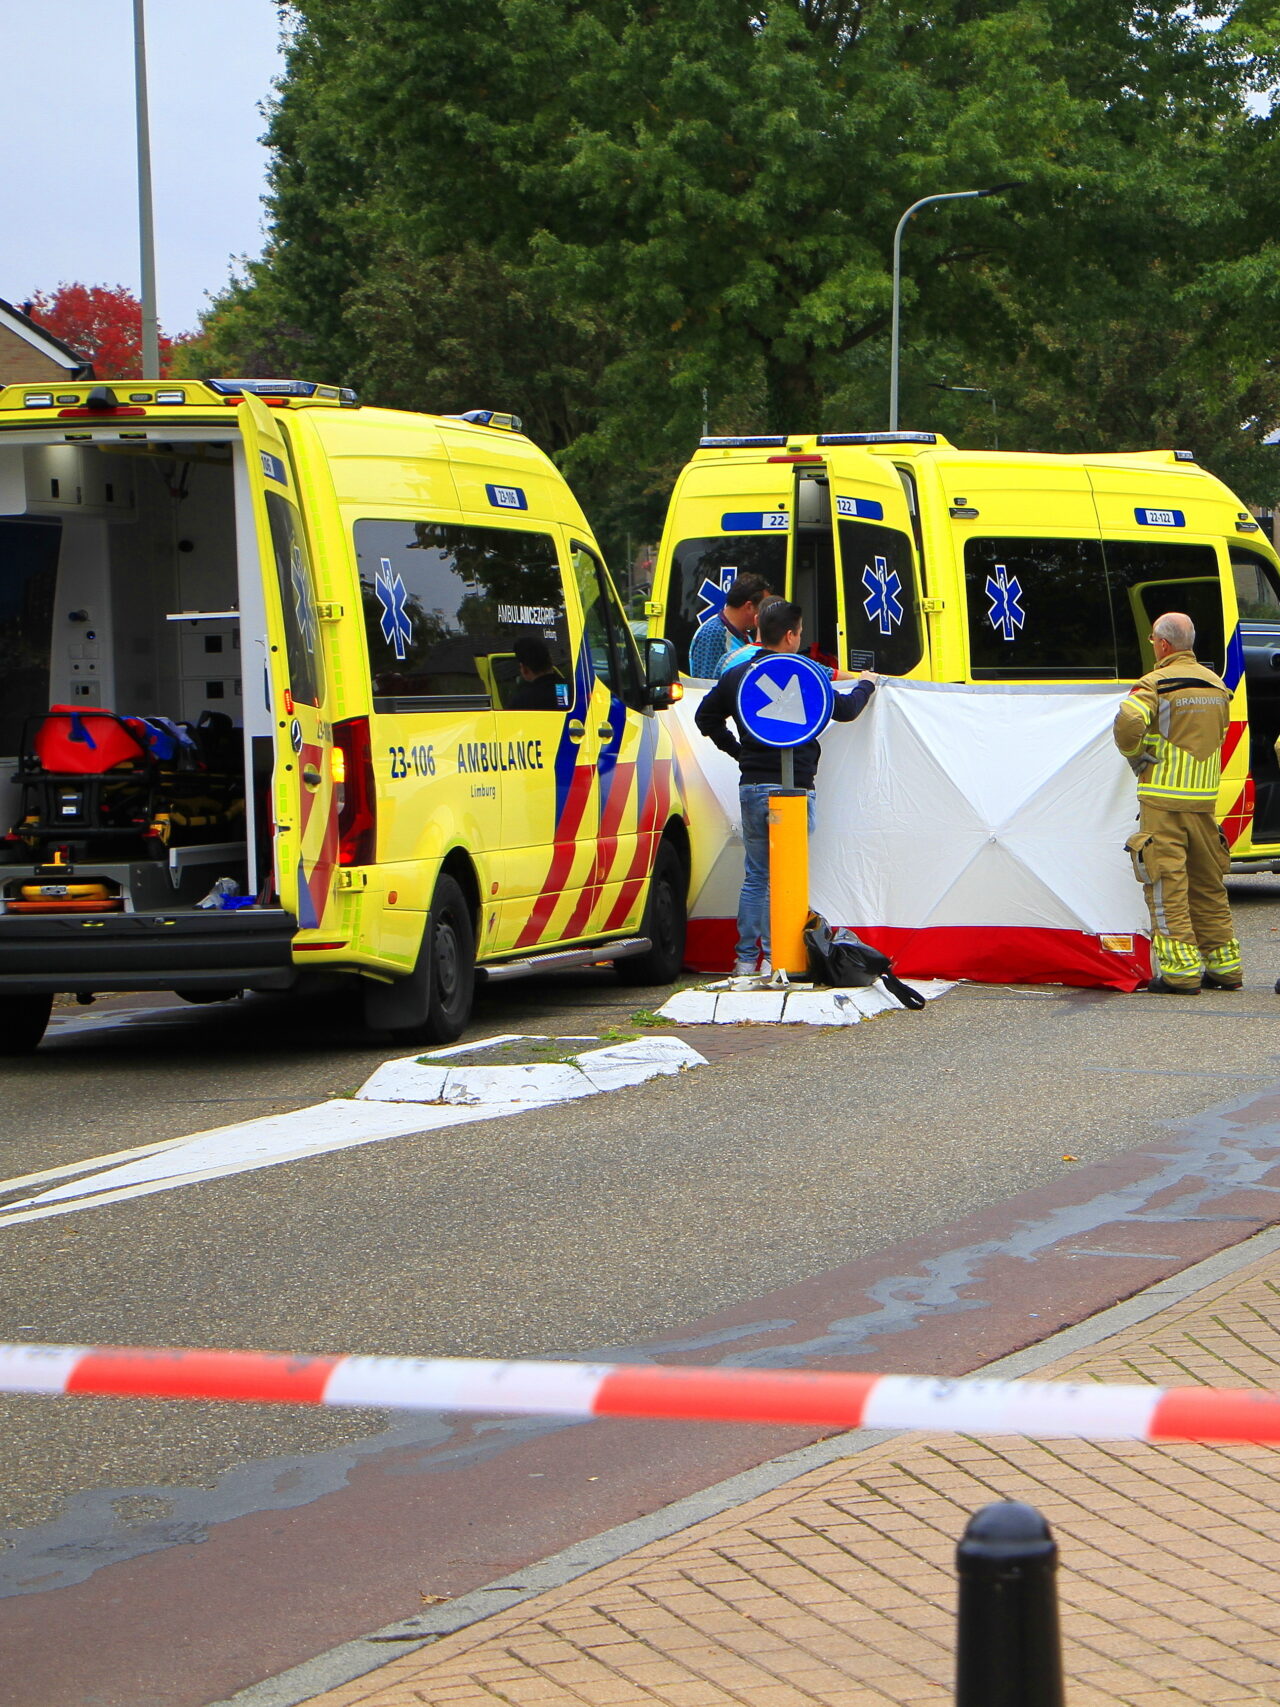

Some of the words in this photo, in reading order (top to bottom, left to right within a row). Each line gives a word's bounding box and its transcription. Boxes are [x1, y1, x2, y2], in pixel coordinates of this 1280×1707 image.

[836, 499, 852, 512] 122
[1149, 511, 1171, 523] 22-122
[388, 745, 436, 779] 23-106
[457, 740, 543, 774] AMBULANCE
[470, 783, 496, 800] Limburg
